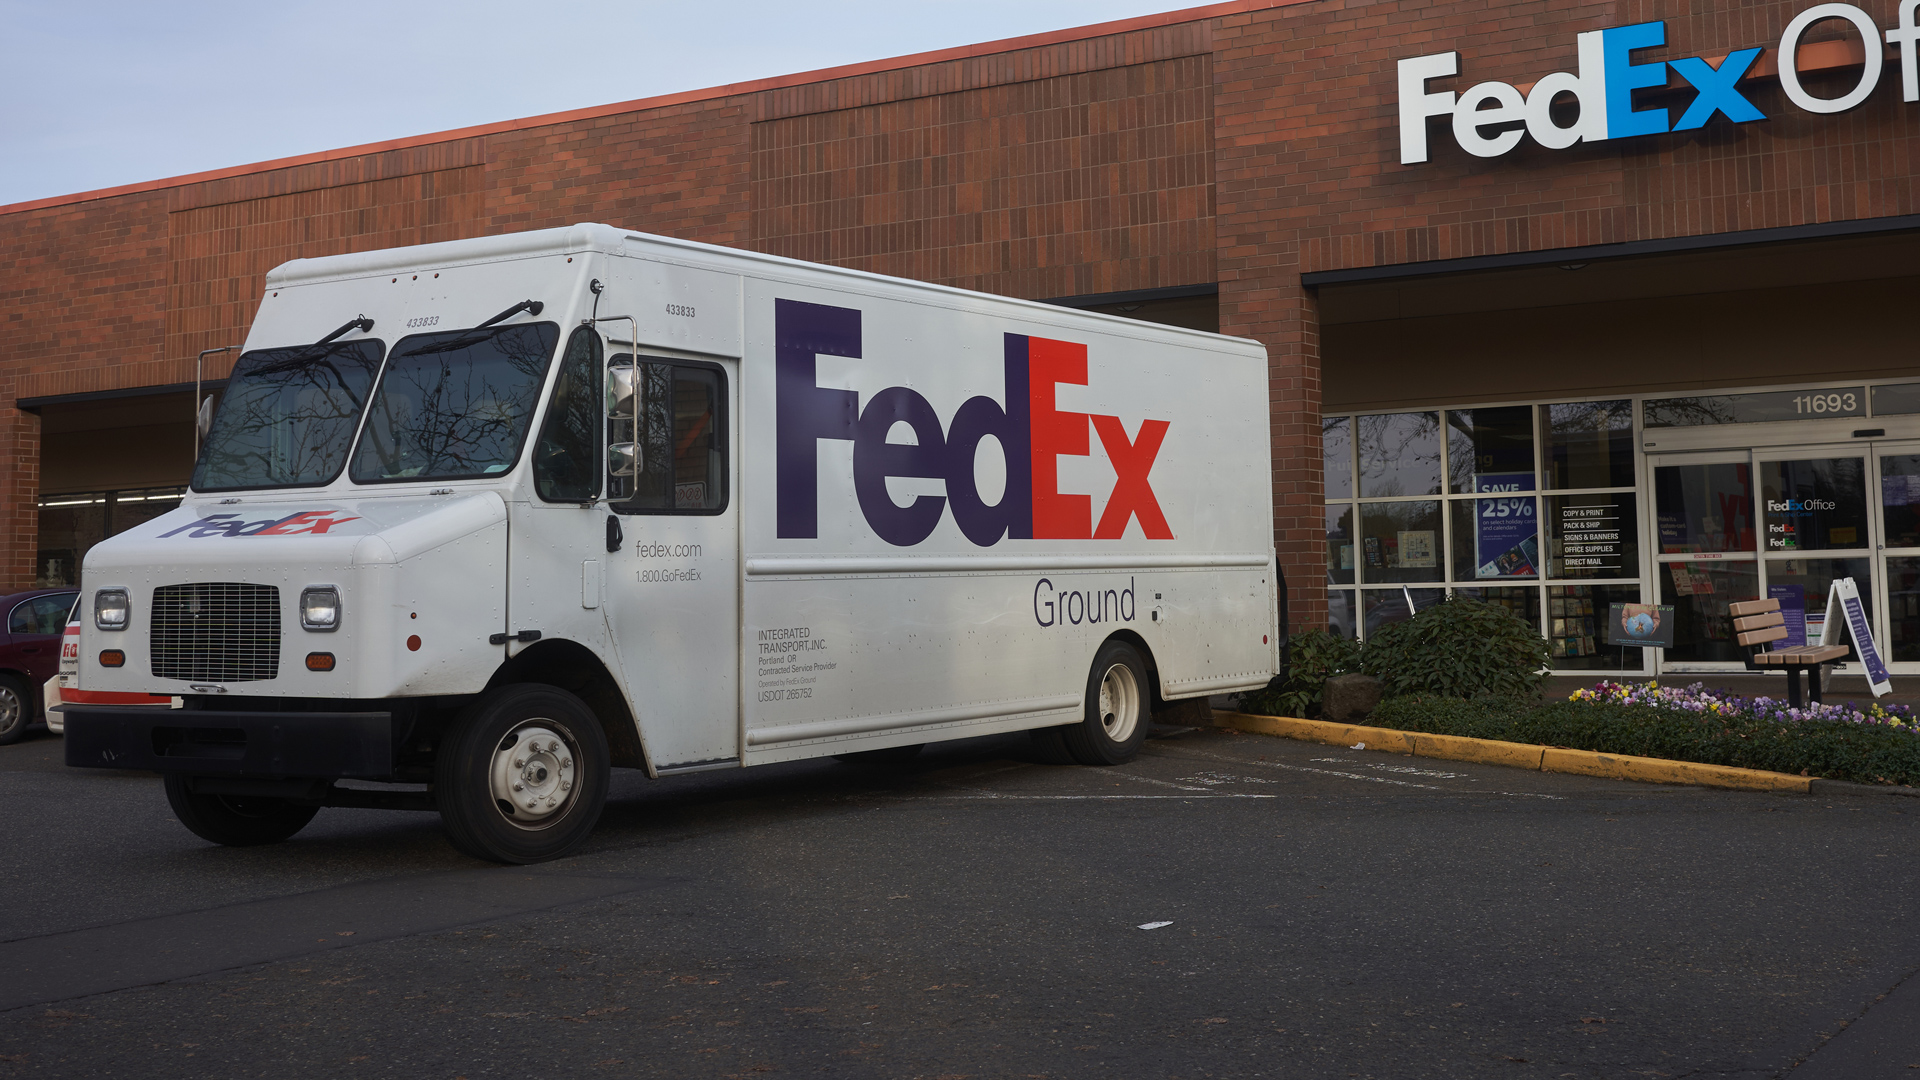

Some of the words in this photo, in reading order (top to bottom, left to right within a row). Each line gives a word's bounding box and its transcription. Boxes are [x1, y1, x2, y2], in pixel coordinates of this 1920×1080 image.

[1397, 20, 1768, 165] FedEx
[665, 304, 696, 318] 433833
[405, 315, 440, 330] 433833
[1792, 393, 1857, 414] 11693
[775, 298, 1174, 546] FedEx
[1327, 459, 1351, 472] Ful
[1481, 483, 1520, 493] SAVE
[1482, 497, 1533, 518] 25%
[1767, 499, 1804, 512] FedEx
[1804, 498, 1836, 511] Office
[156, 509, 363, 539] FedEx
[1505, 518, 1523, 526] holiday
[1769, 523, 1795, 532] FedEx
[1584, 533, 1589, 541] &
[1590, 533, 1619, 541] BANNERS
[1769, 538, 1795, 547] FedEx
[636, 540, 702, 558] fedex.com
[1585, 545, 1613, 553] SUPPLIES
[1565, 558, 1586, 566] DIRECT
[636, 568, 702, 583] 1.800.GoFedEx
[1034, 576, 1136, 628] Ground
[758, 627, 811, 641] INTEGRATED
[758, 640, 811, 655] TRANSPORT,
[811, 638, 828, 651] INC.
[758, 655, 785, 666] Portland
[787, 654, 797, 664] OR
[758, 665, 791, 677] Contracted
[791, 664, 813, 674] Service
[814, 661, 837, 671] Provider
[758, 679, 779, 688] Operated
[779, 678, 786, 687] by
[786, 677, 800, 686] FedEx
[800, 676, 817, 684] Ground
[757, 689, 785, 703] USDOT
[786, 687, 813, 701] 265752
